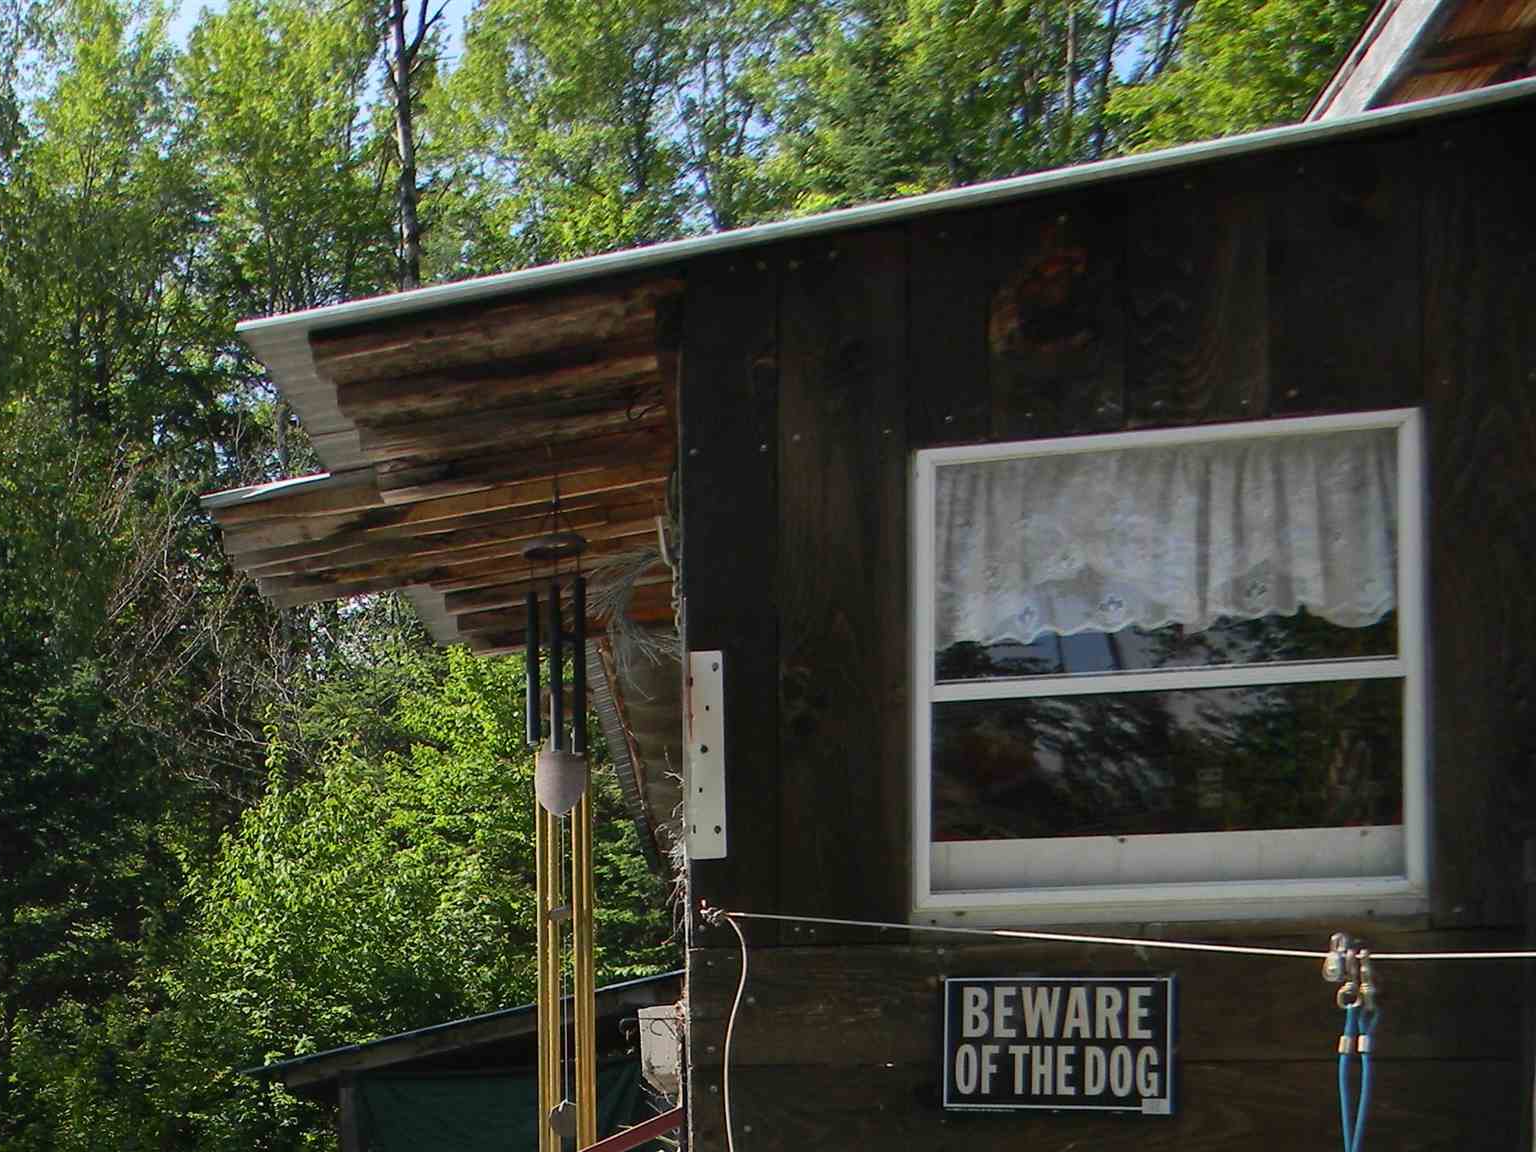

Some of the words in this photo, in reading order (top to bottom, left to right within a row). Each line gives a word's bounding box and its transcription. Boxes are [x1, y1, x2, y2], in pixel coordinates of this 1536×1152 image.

[962, 986, 1152, 1040] BEWARE
[955, 1044, 1000, 1096] OF
[1008, 1045, 1077, 1096] THE
[1084, 1045, 1159, 1098] DOG
